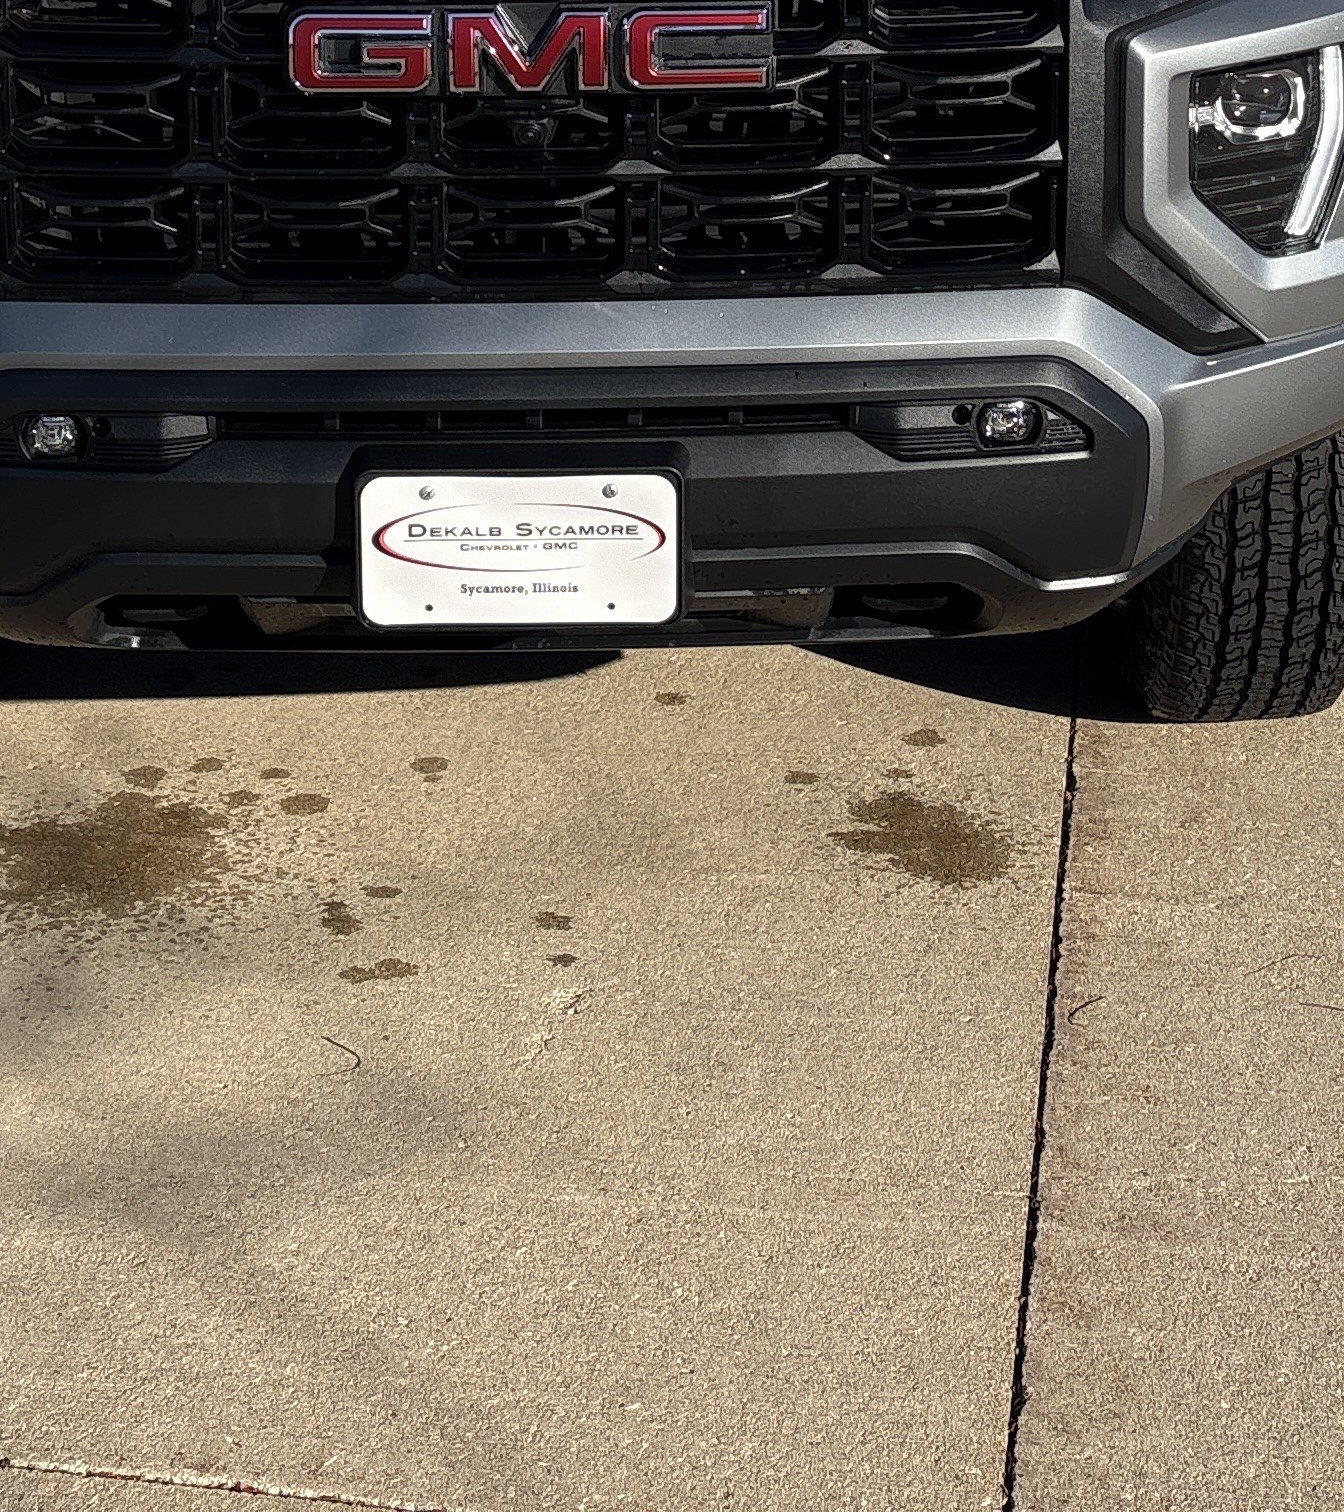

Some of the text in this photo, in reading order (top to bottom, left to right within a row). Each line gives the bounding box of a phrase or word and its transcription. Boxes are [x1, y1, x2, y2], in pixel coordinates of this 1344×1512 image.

[287, 4, 772, 94] GMC
[515, 522, 639, 537] SYCAMORE
[459, 541, 579, 552] CHEVROLET GMC
[460, 582, 579, 597] Sycamore, Illinois
